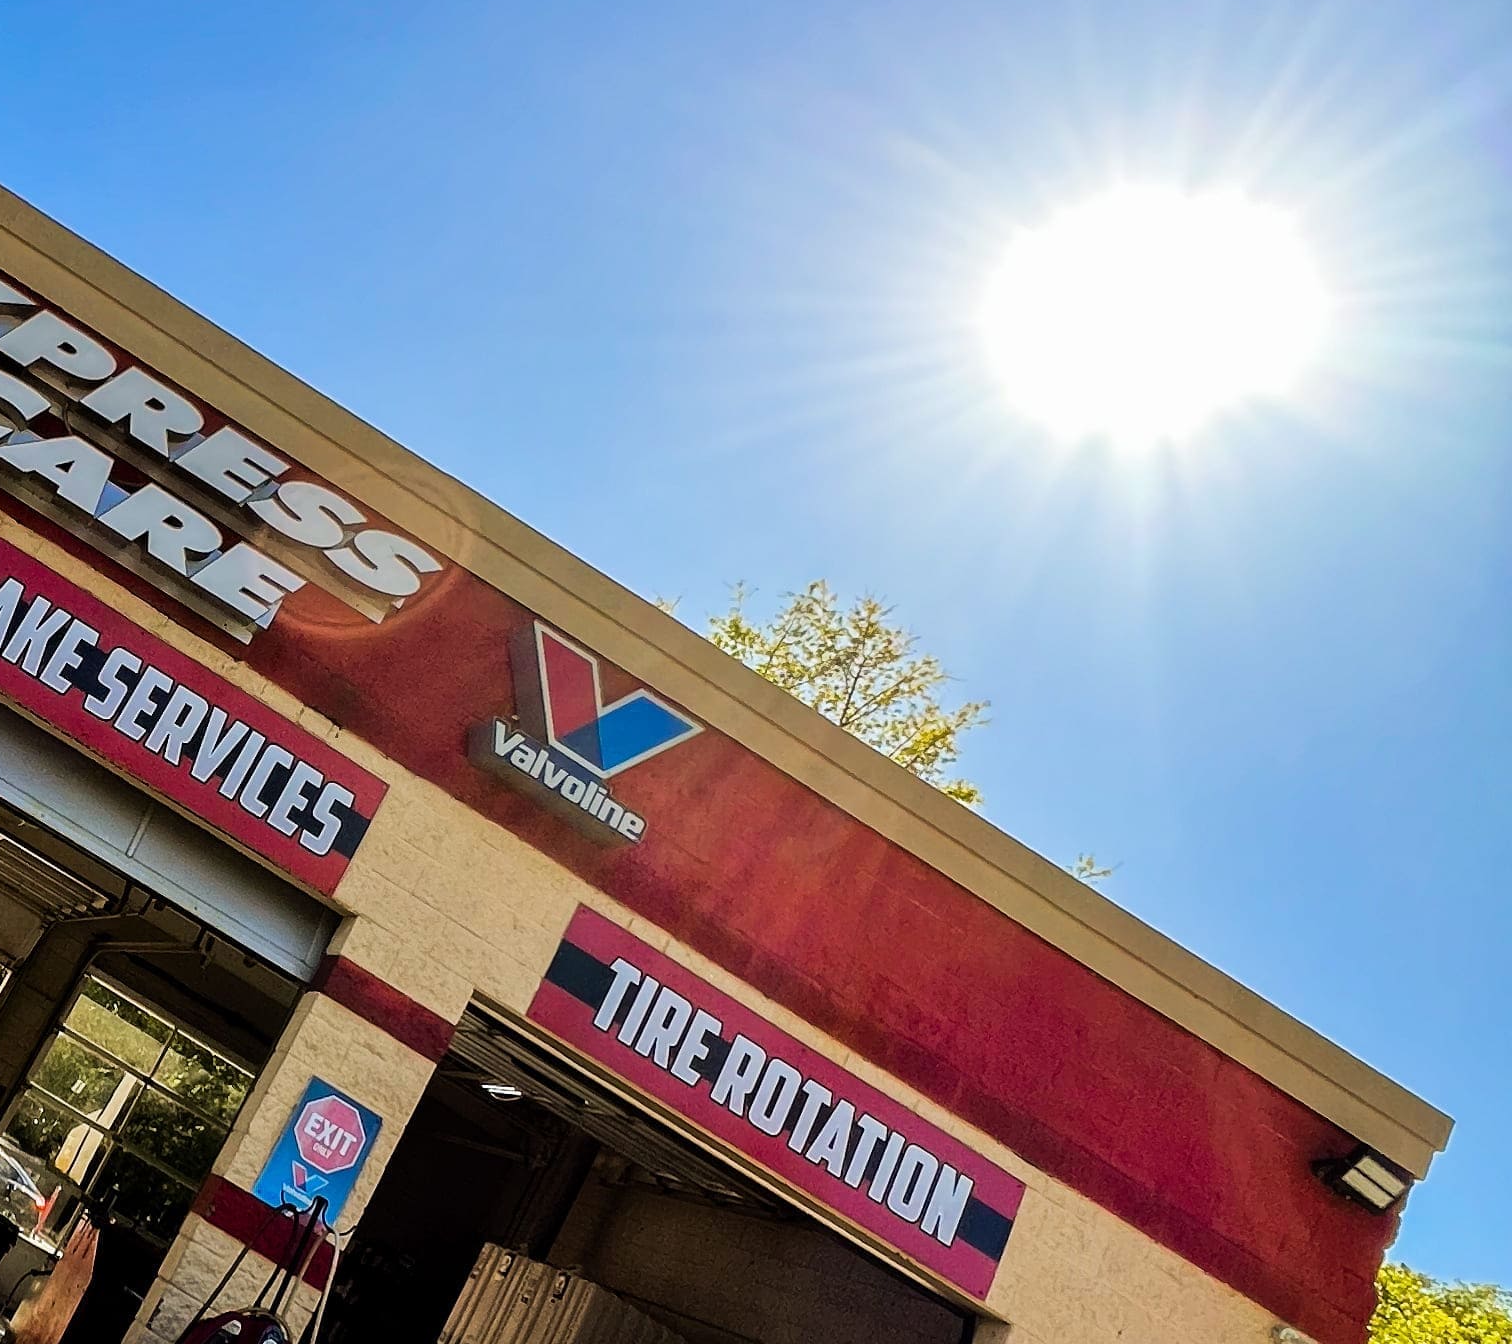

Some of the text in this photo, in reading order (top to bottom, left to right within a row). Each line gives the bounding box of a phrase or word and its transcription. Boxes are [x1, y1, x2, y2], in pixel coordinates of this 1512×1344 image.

[83, 646, 355, 856] SERVICES
[494, 720, 647, 843] Valvoline
[303, 1112, 357, 1156] EXIT
[592, 957, 975, 1246] TIRE ROTATION
